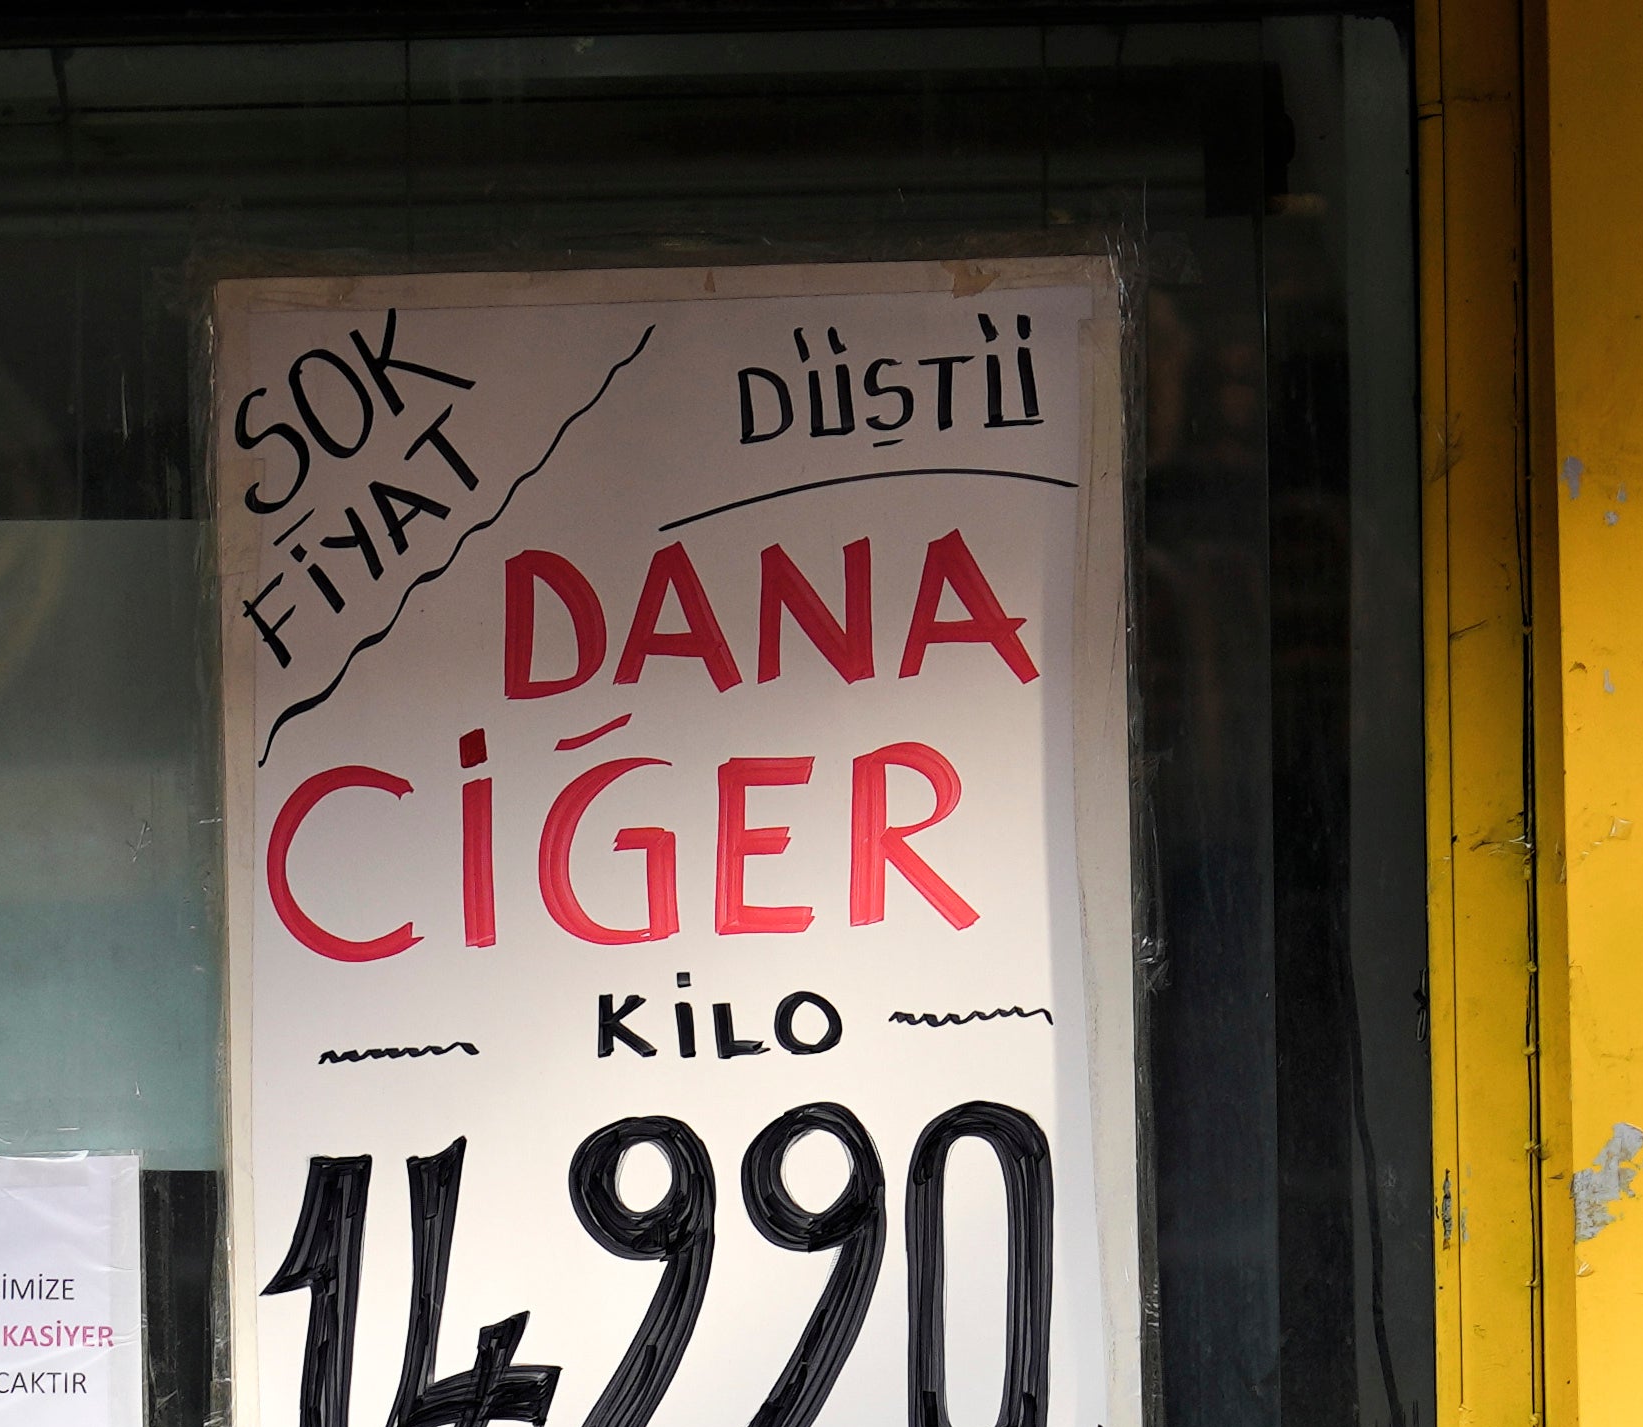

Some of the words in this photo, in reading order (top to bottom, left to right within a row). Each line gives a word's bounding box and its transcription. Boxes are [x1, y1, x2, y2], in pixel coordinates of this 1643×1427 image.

[737, 313, 1044, 447] DÜŞTÜ
[242, 405, 480, 668] FİYAT
[505, 528, 1041, 700] DANA
[266, 712, 981, 963] CİĞER
[596, 972, 843, 1060] KİLO
[3, 1319, 115, 1348] KASİYER
